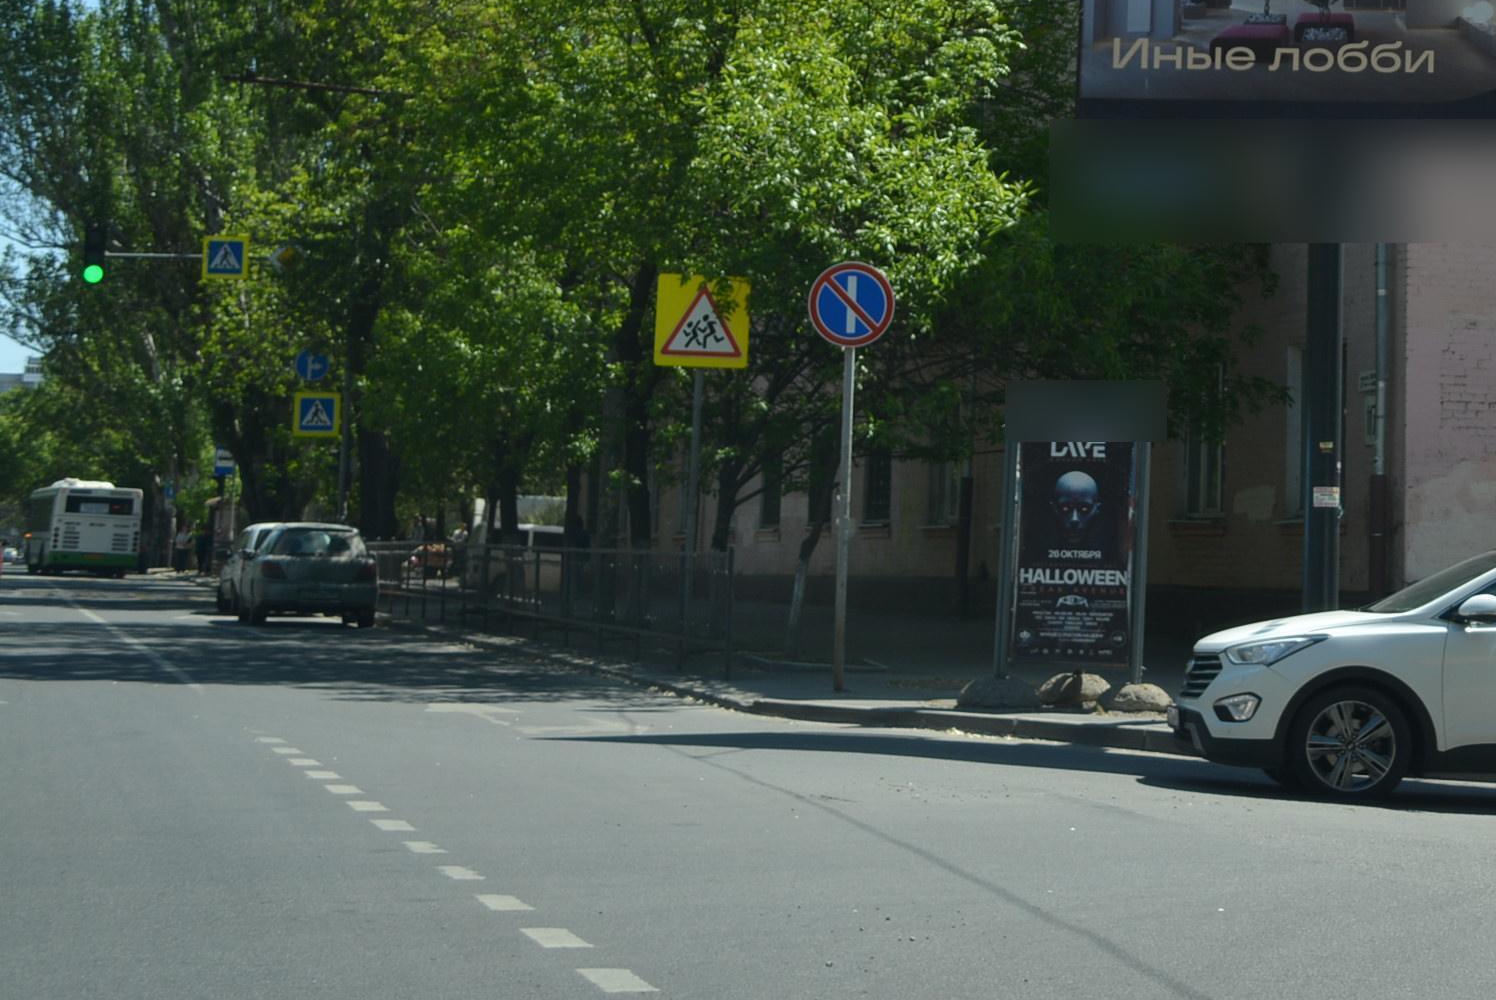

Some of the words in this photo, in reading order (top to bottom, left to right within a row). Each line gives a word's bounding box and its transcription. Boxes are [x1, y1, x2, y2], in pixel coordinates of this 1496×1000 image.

[1112, 36, 1257, 71] Иные
[1269, 39, 1435, 74] лобби
[1061, 549, 1102, 560] ОКТЯБРЯ
[1019, 567, 1129, 586] HALLOWEEN
